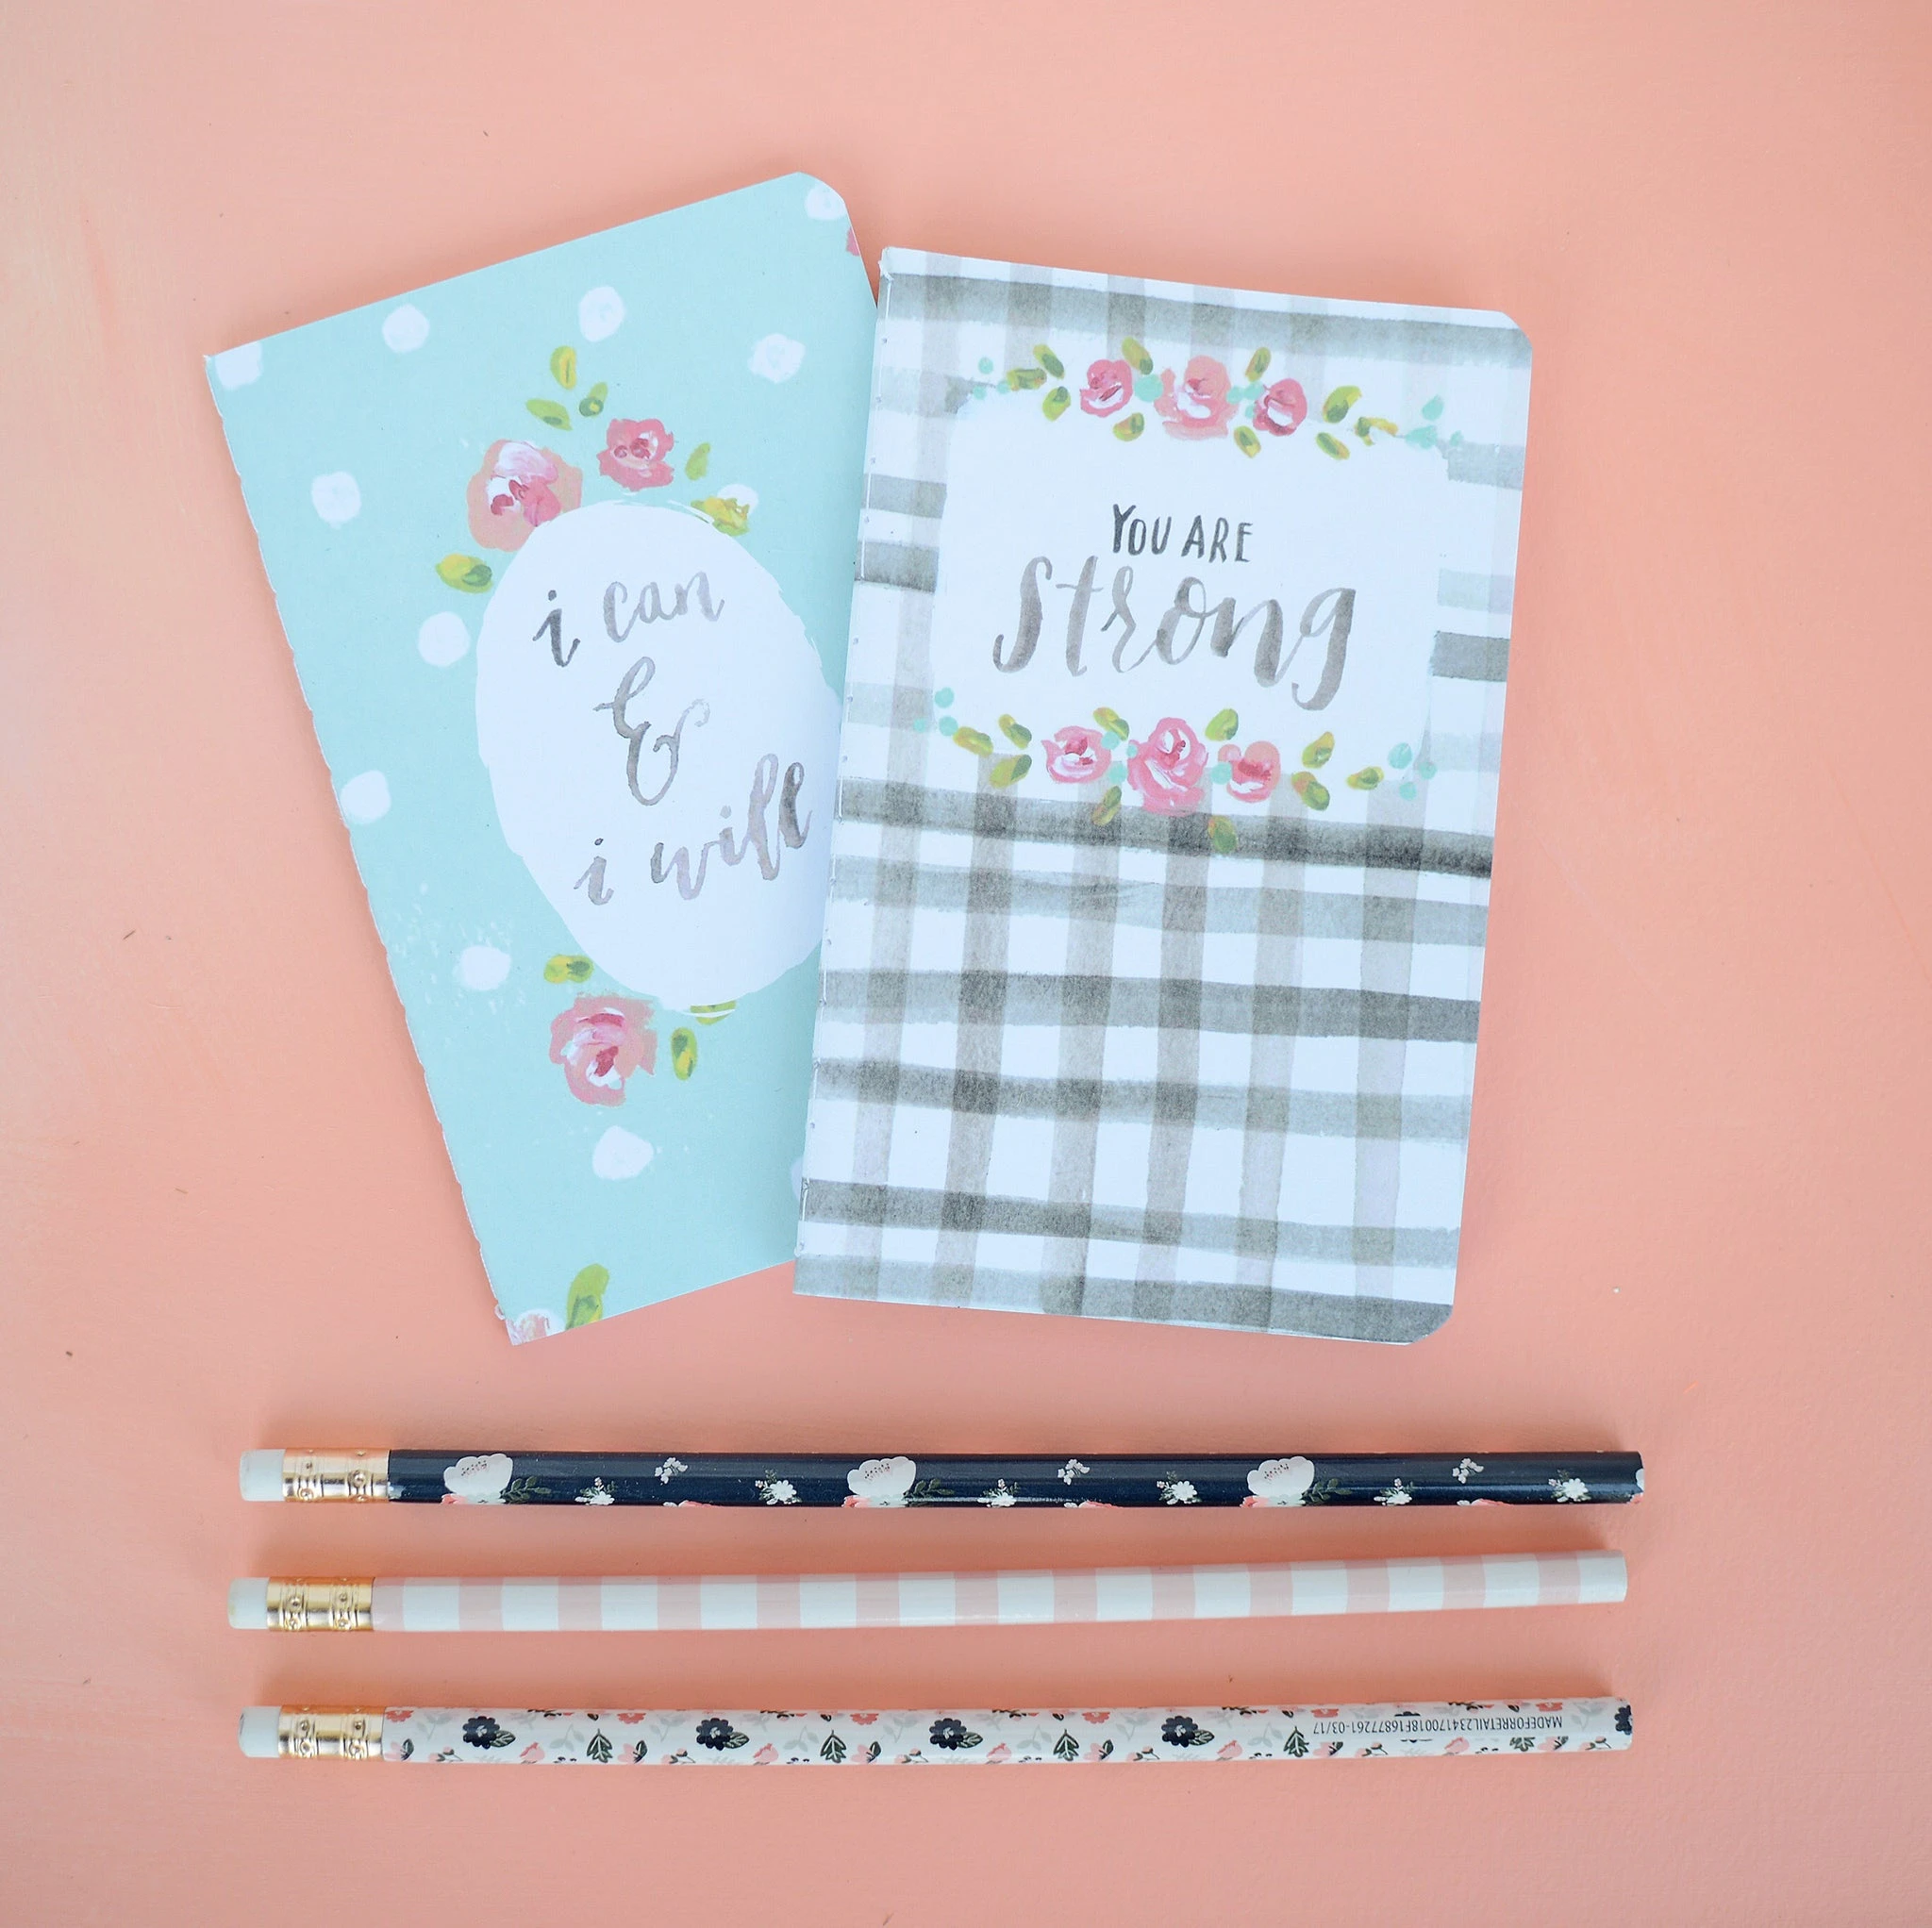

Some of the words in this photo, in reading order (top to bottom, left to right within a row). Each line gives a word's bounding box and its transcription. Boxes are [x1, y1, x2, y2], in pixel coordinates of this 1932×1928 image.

[1112, 503, 1172, 555] YOU
[1181, 515, 1253, 563] ARE
[603, 571, 725, 643] can
[592, 657, 711, 806] &
[650, 753, 813, 900] will
